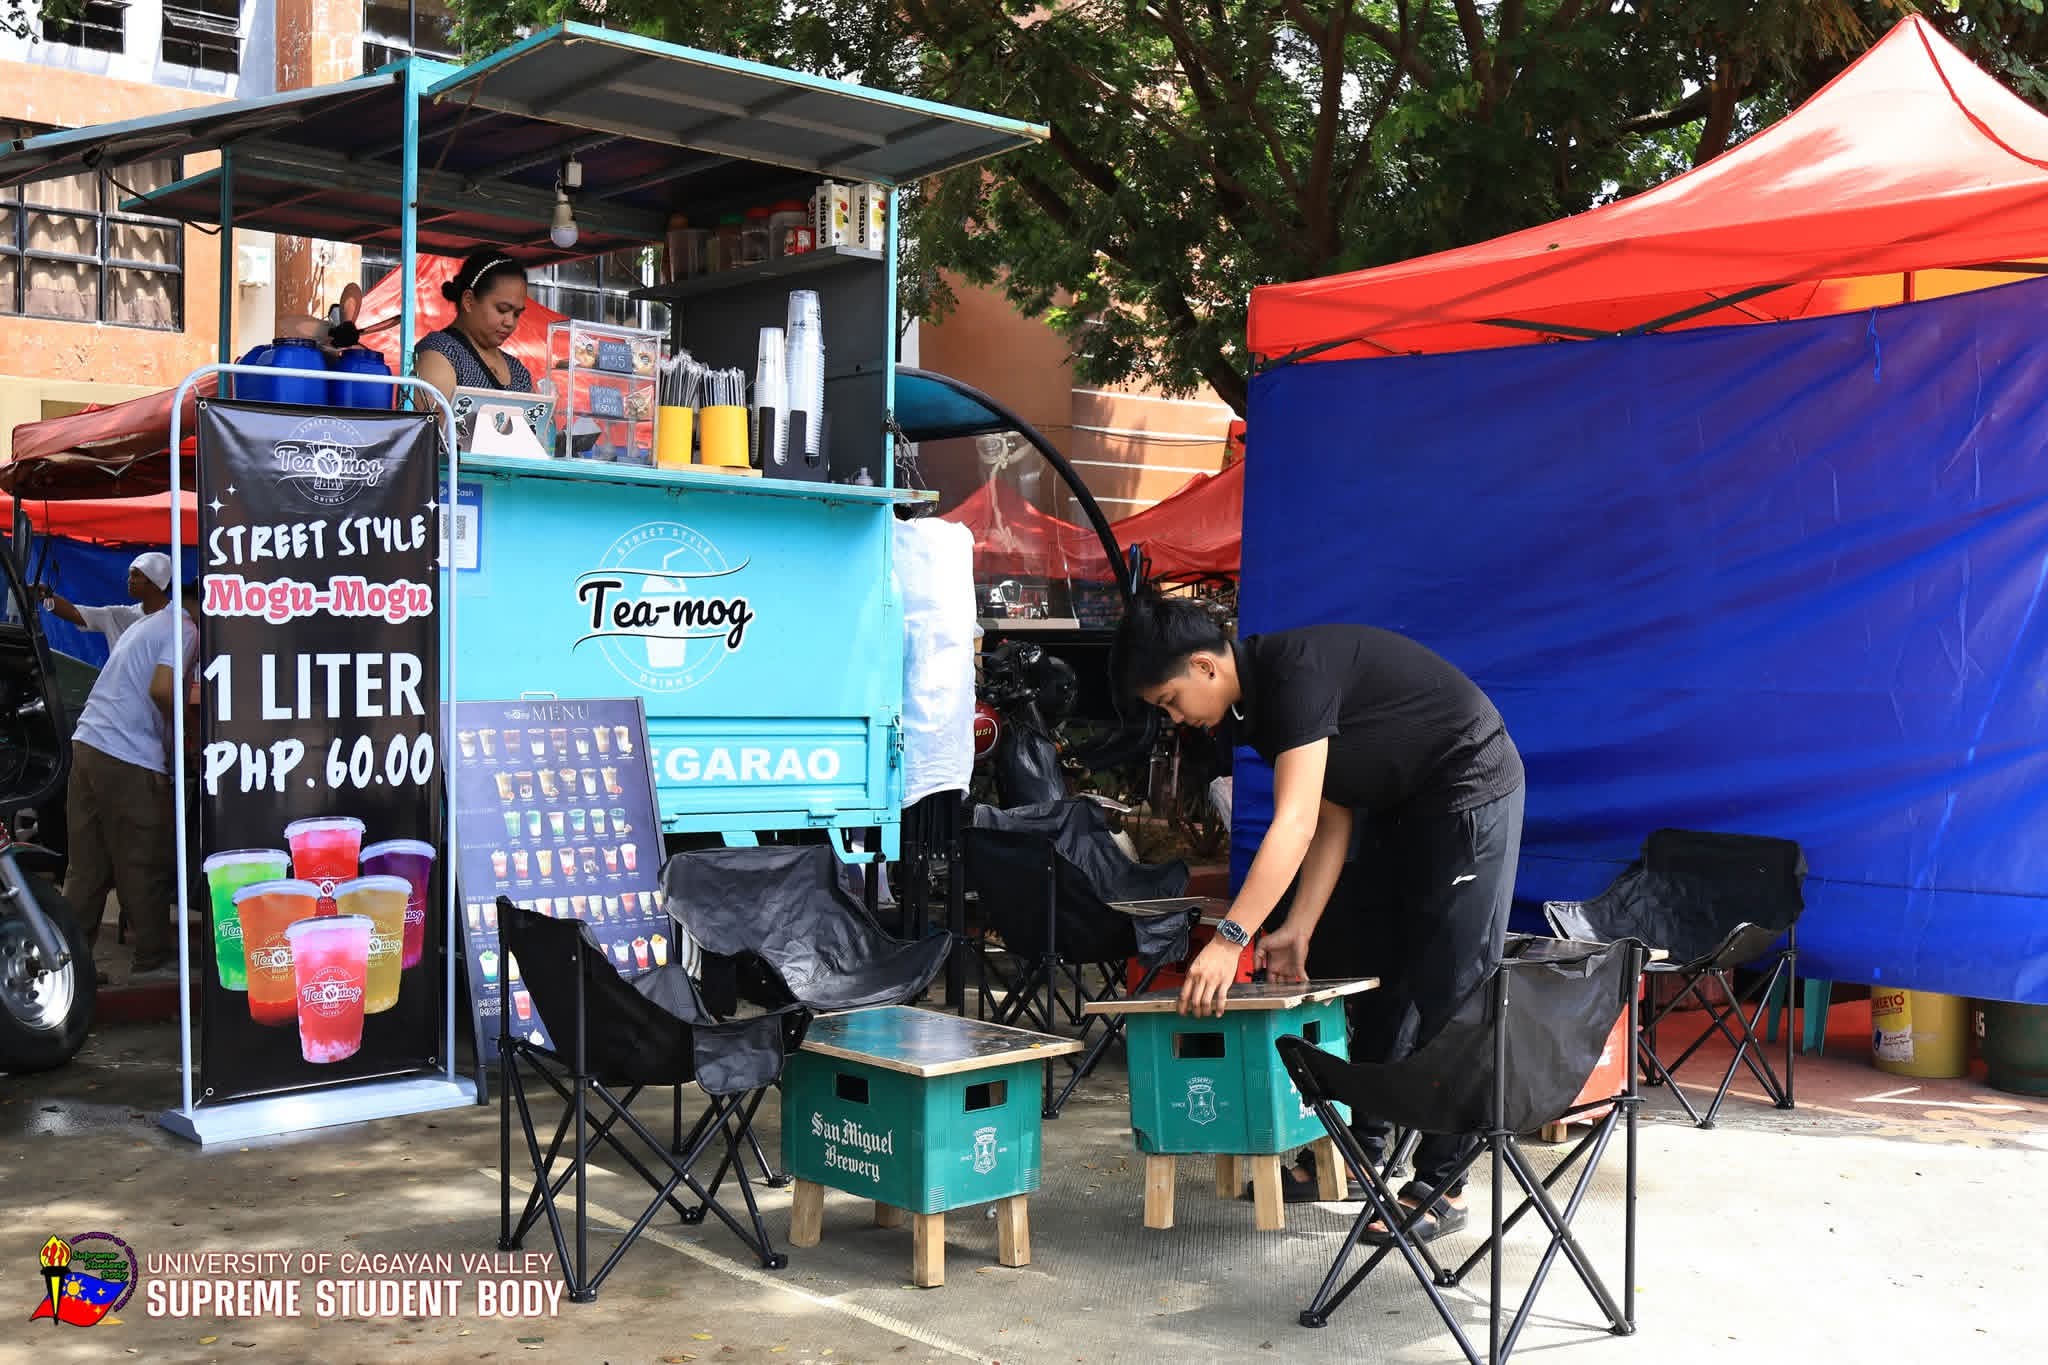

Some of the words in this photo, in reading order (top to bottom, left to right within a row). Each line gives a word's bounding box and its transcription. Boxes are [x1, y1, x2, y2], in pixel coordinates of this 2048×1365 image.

[314, 495, 345, 504] DRINKS
[208, 519, 328, 566] STREET
[338, 514, 427, 556] STYLE
[617, 527, 665, 554] STREET
[671, 527, 712, 555] STYLE
[203, 574, 432, 623] Mogu-Mogu
[578, 580, 753, 649] Tea-mog
[203, 653, 232, 721] 1
[262, 652, 426, 720] LITER
[639, 673, 694, 687] DRINKS
[811, 1111, 840, 1141] San
[841, 1119, 894, 1156] Miguel
[824, 1143, 881, 1183] Brewery
